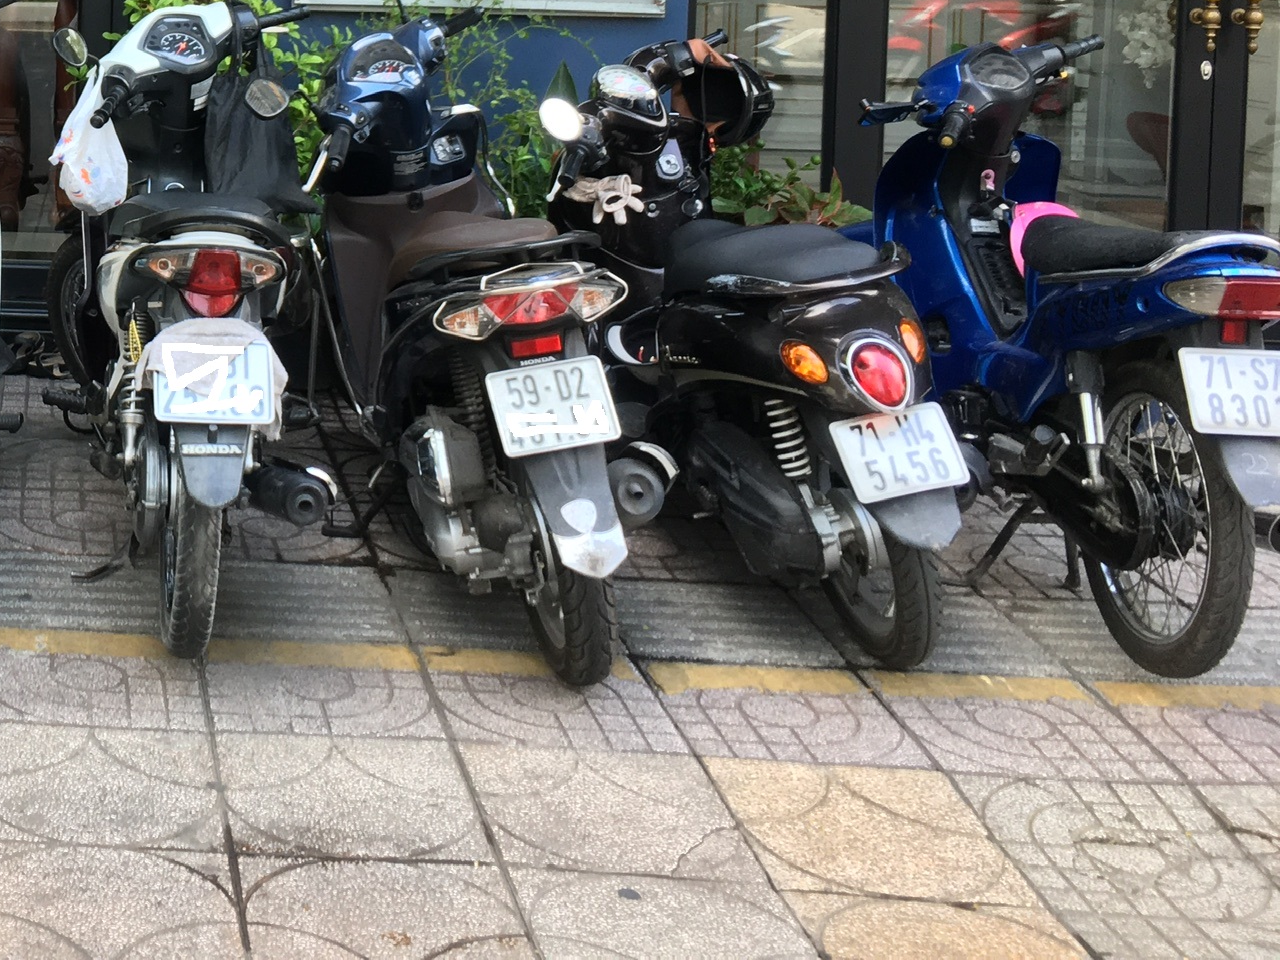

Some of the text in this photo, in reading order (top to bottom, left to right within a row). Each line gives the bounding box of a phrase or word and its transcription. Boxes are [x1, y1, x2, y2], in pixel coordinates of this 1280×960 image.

[520, 355, 557, 366] HONDA
[505, 367, 590, 410] 59-D2
[181, 443, 243, 455] HONDA
[848, 412, 935, 457] 71-H4
[864, 447, 951, 492] 5456
